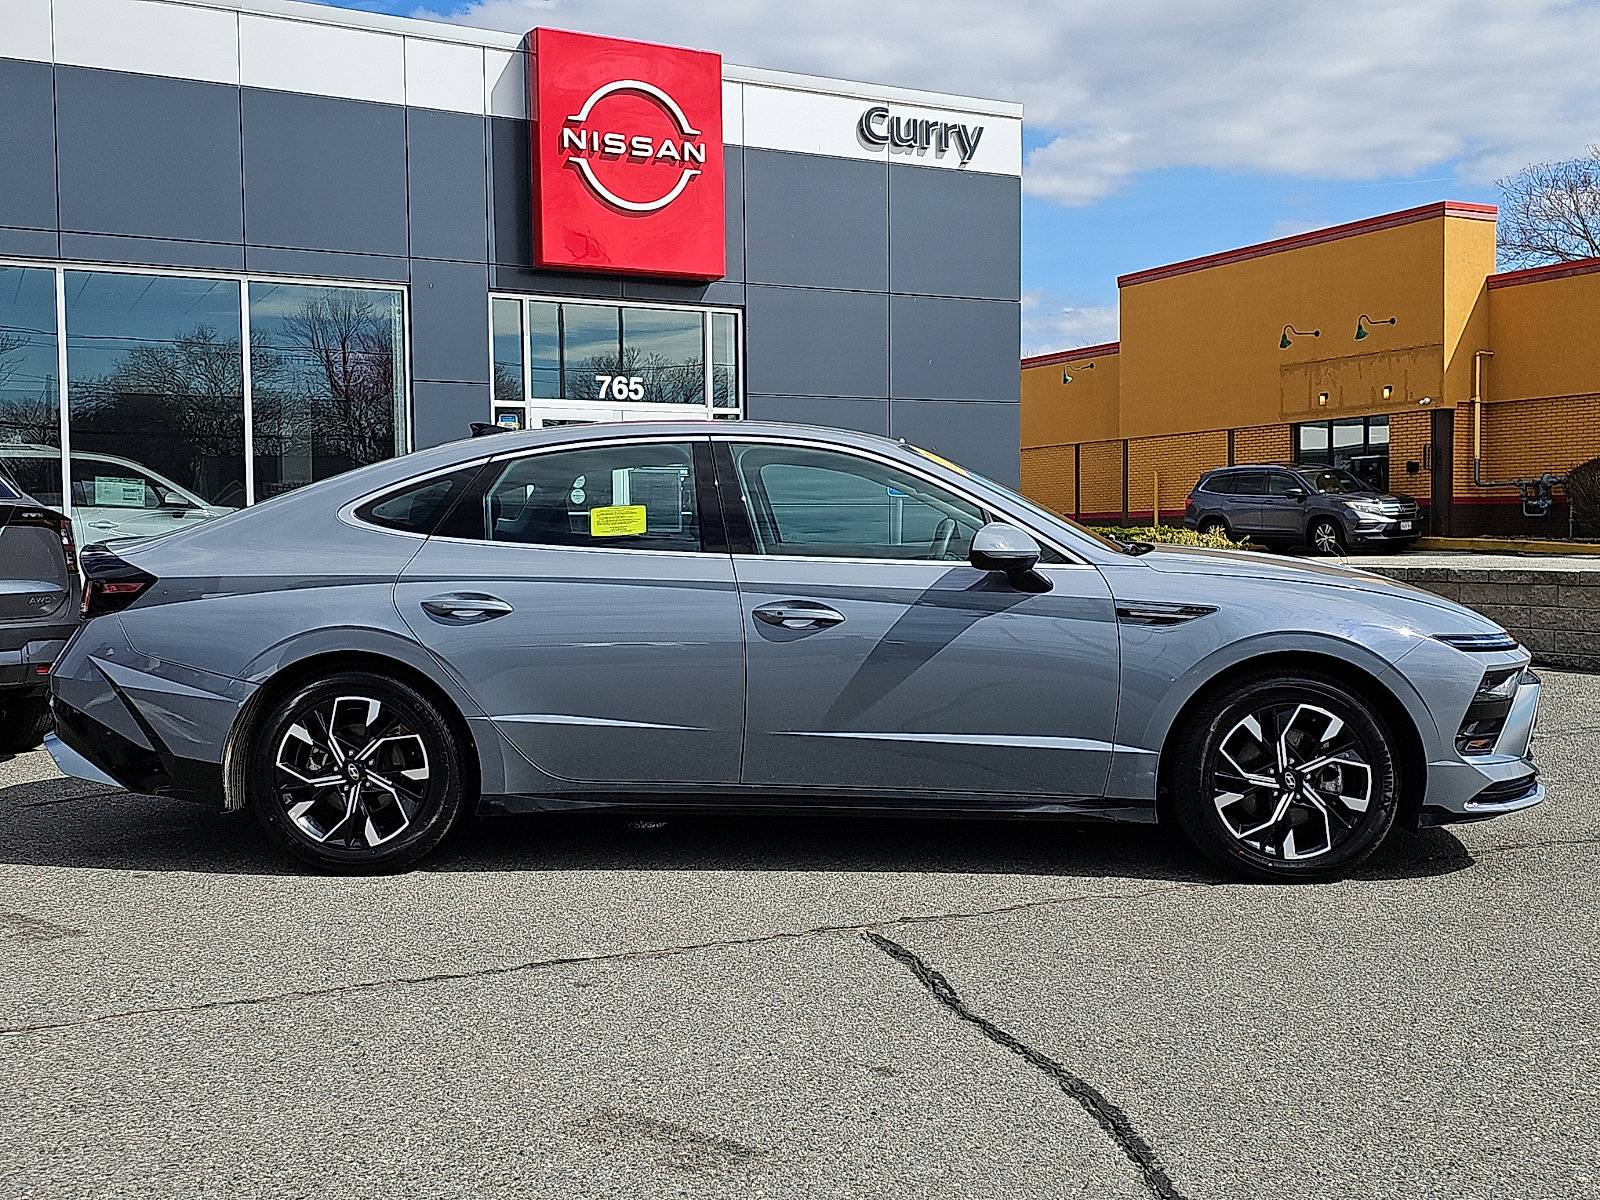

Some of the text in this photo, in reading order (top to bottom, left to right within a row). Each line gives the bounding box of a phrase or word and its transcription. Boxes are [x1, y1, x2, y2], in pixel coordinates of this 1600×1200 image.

[562, 127, 706, 163] NISSAN
[861, 106, 984, 162] Curry
[595, 375, 645, 400] 765
[28, 596, 52, 605] AWD
